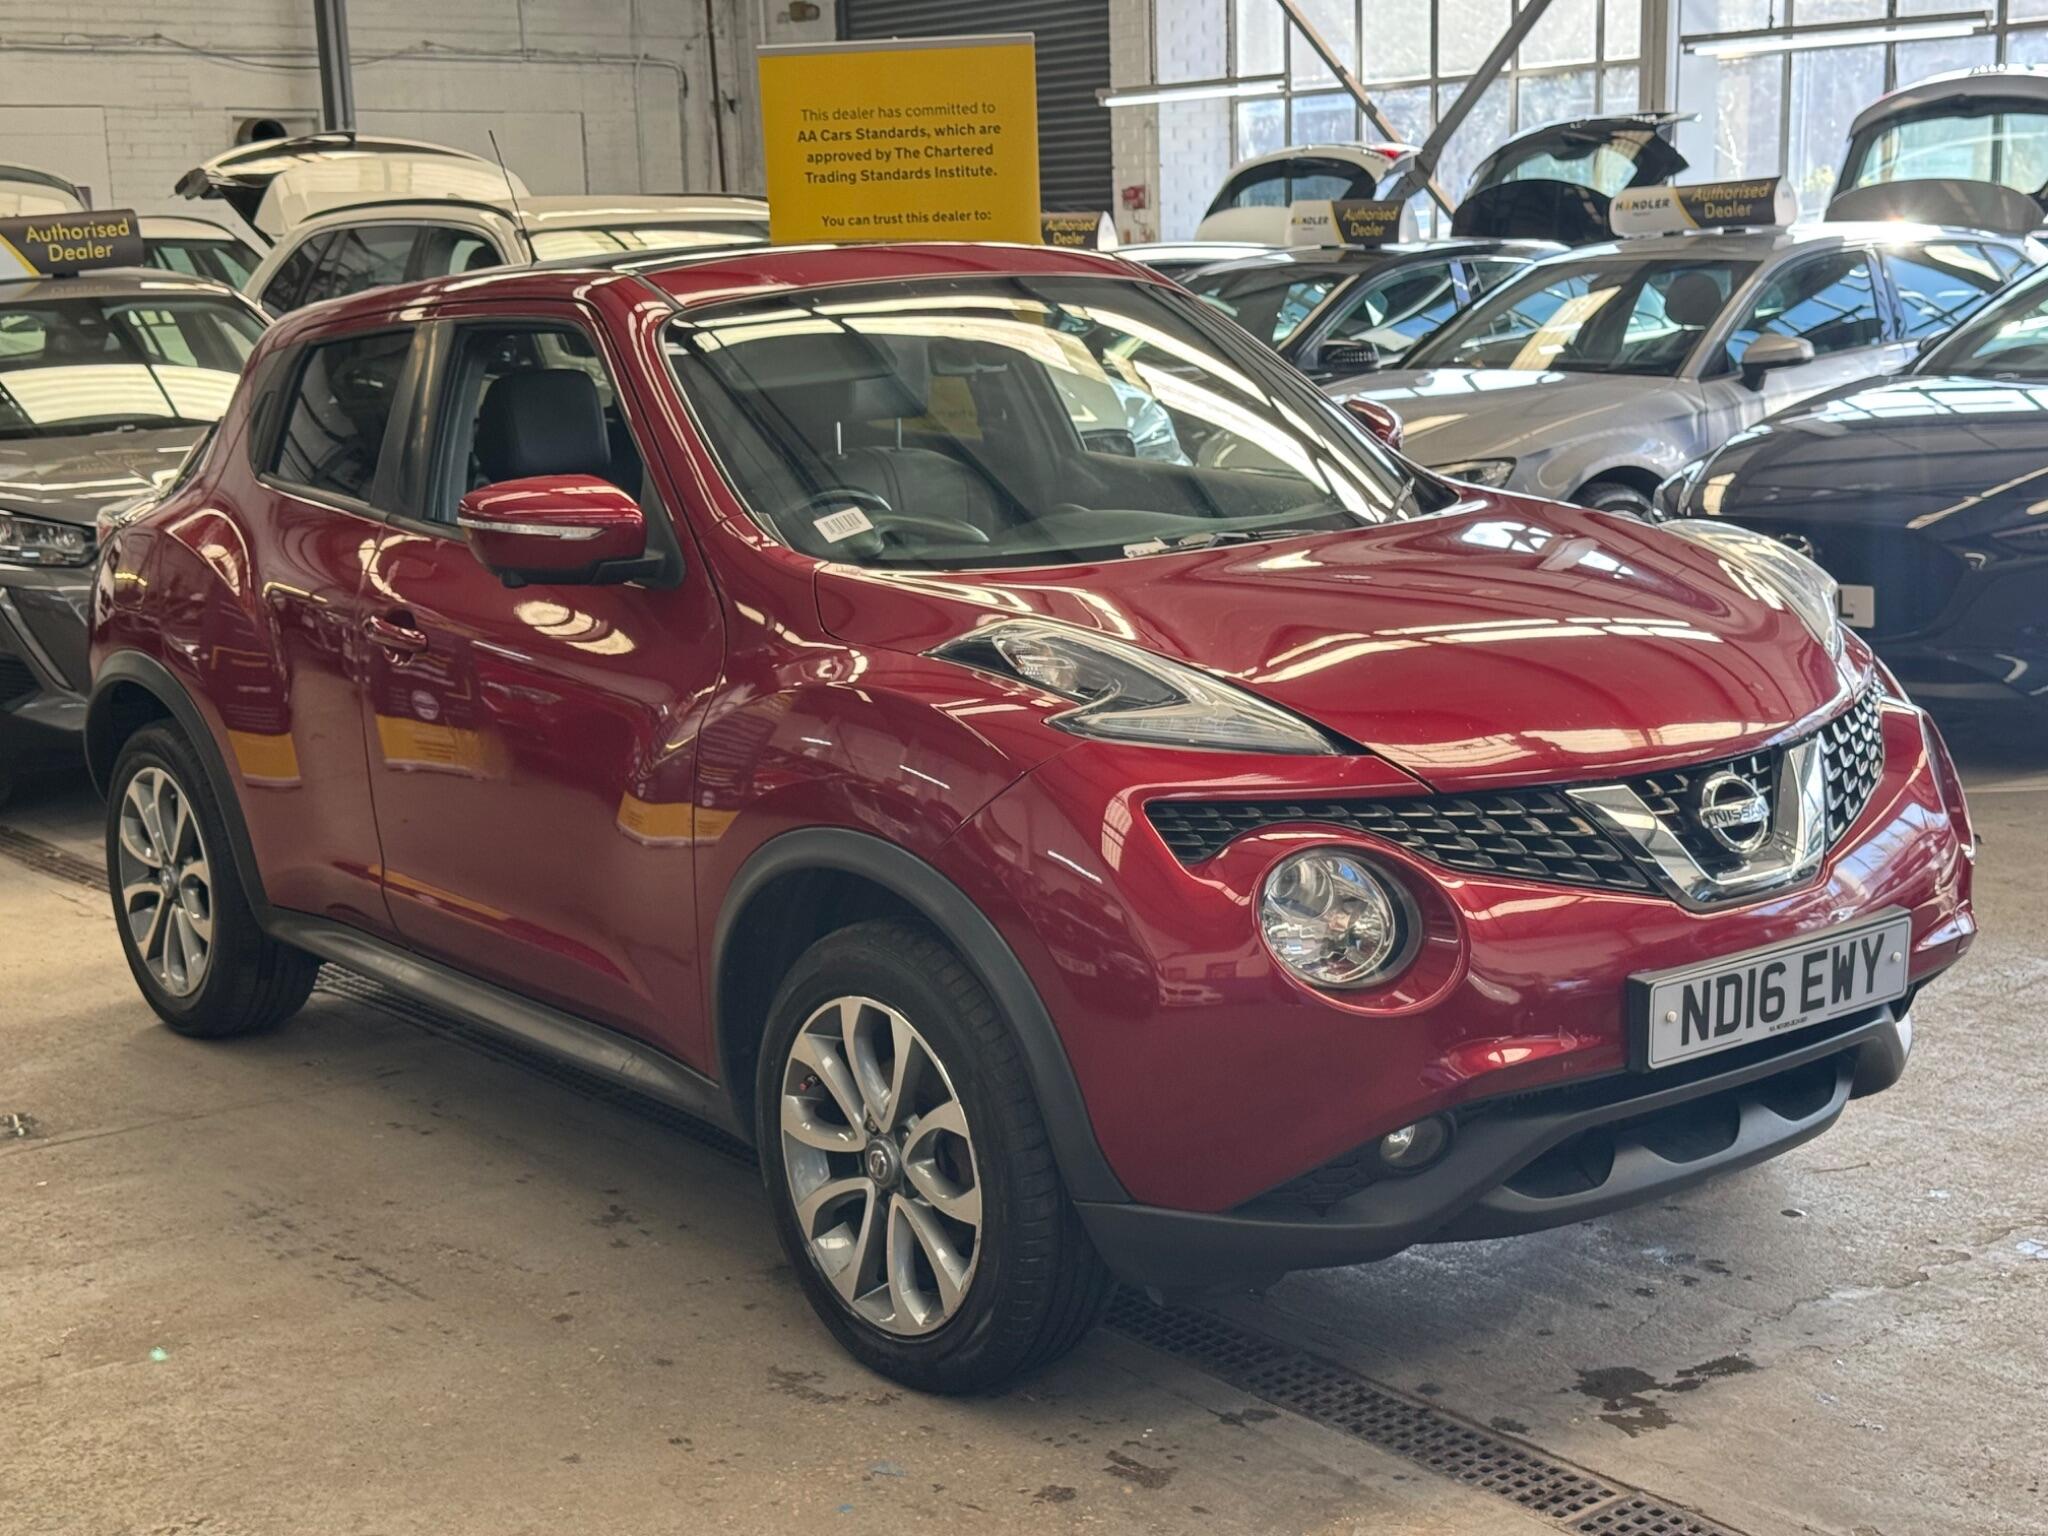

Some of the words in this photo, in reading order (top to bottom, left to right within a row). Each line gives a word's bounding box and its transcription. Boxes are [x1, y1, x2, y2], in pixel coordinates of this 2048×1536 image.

[801, 109, 829, 121] This
[832, 106, 875, 120] dealer
[878, 105, 902, 118] has
[905, 102, 979, 117] committed
[982, 102, 996, 114] to
[797, 130, 817, 142] AA
[820, 129, 852, 142] Cars
[855, 126, 931, 140] Standards,
[934, 124, 976, 137] which
[979, 124, 1001, 135] are
[807, 150, 872, 164] approved
[876, 149, 892, 162] by
[895, 147, 920, 159] The
[924, 144, 994, 158] Chartered
[805, 171, 857, 185] Trading
[860, 168, 931, 181] Standards
[935, 165, 998, 178] Institute.
[1691, 182, 1769, 202] Authorised
[821, 215, 845, 227] You
[848, 216, 870, 226] can
[873, 213, 903, 224] trust
[906, 211, 929, 223] this
[932, 210, 972, 222] dealer
[974, 210, 991, 220] to:
[1343, 206, 1399, 221] Authorised
[1704, 200, 1752, 219] Dealer
[26, 218, 130, 243] Authorised
[1053, 231, 1085, 245] Dealer
[1350, 221, 1385, 237] Dealer
[49, 240, 113, 262] Dealer
[1681, 960, 1786, 1046] ND16
[1799, 932, 1885, 1014] EWY
